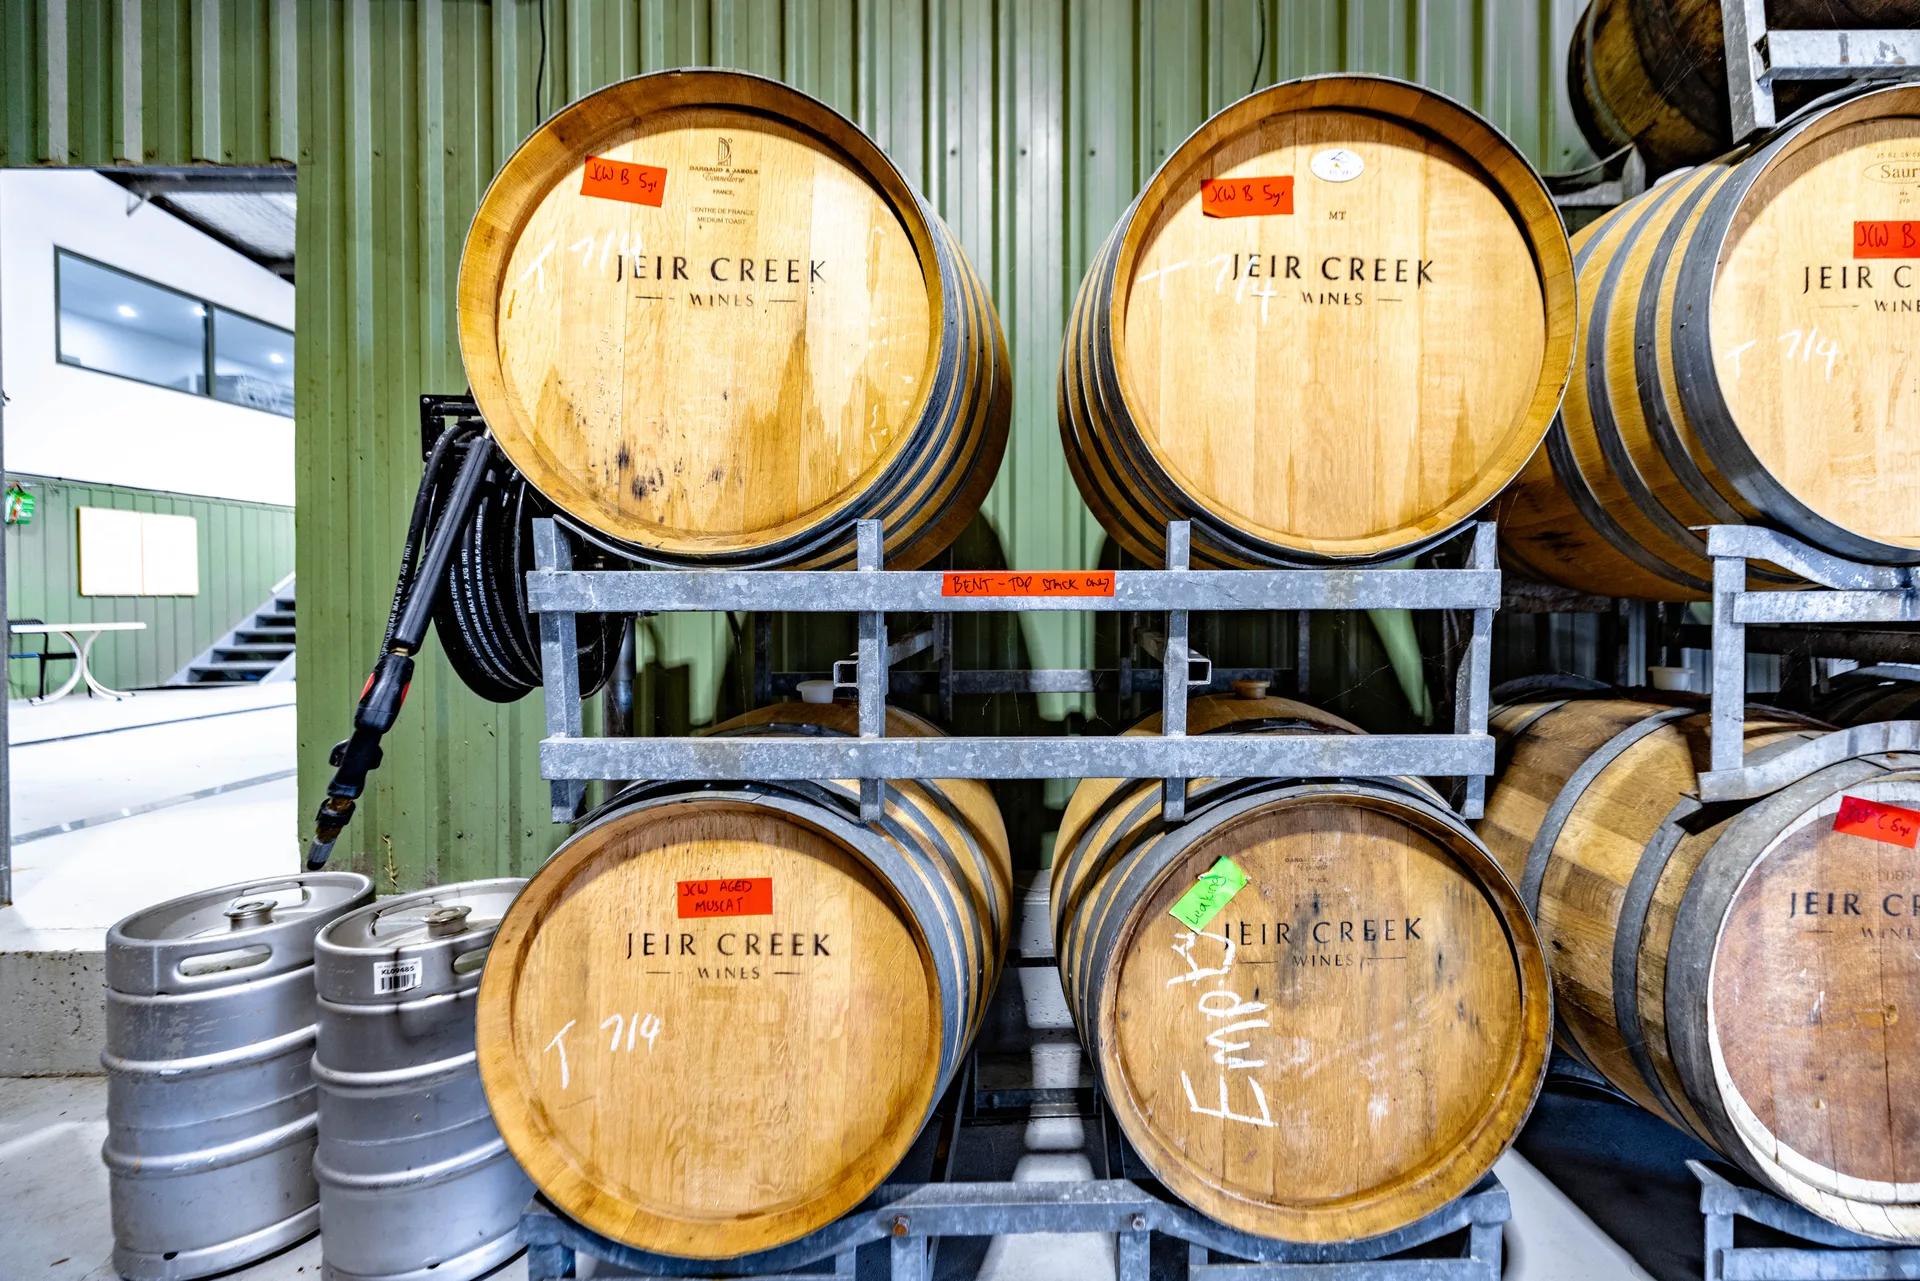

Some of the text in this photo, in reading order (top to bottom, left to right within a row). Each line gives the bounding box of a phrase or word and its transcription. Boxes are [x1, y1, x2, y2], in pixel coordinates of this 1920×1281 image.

[621, 168, 630, 185] B
[1881, 165, 1920, 179] Saur
[1242, 184, 1252, 202] B
[697, 216, 747, 225] MEDIUM TOAST
[727, 208, 755, 216] FRANCE
[1329, 211, 1346, 220] MT
[1902, 223, 1916, 248] B
[616, 254, 826, 285] JEIR CREEK
[1233, 254, 1434, 285] JEIR CREEK
[1803, 265, 1873, 294] JEIR
[689, 291, 754, 307] WINES
[1301, 292, 1364, 307] WINES
[953, 576, 994, 593] BENT
[1008, 576, 1033, 593] TOP
[1042, 578, 1080, 591] STACK
[682, 880, 753, 898] JCW AGED
[695, 898, 744, 914] MUSCAT
[1790, 893, 1862, 919] JEIR
[1223, 917, 1422, 951] JEIR CREEK
[626, 932, 832, 960] JEIR CREEK
[1293, 953, 1354, 967] WINES
[697, 966, 760, 980] WINES
[1167, 930, 1279, 1128] Empty
